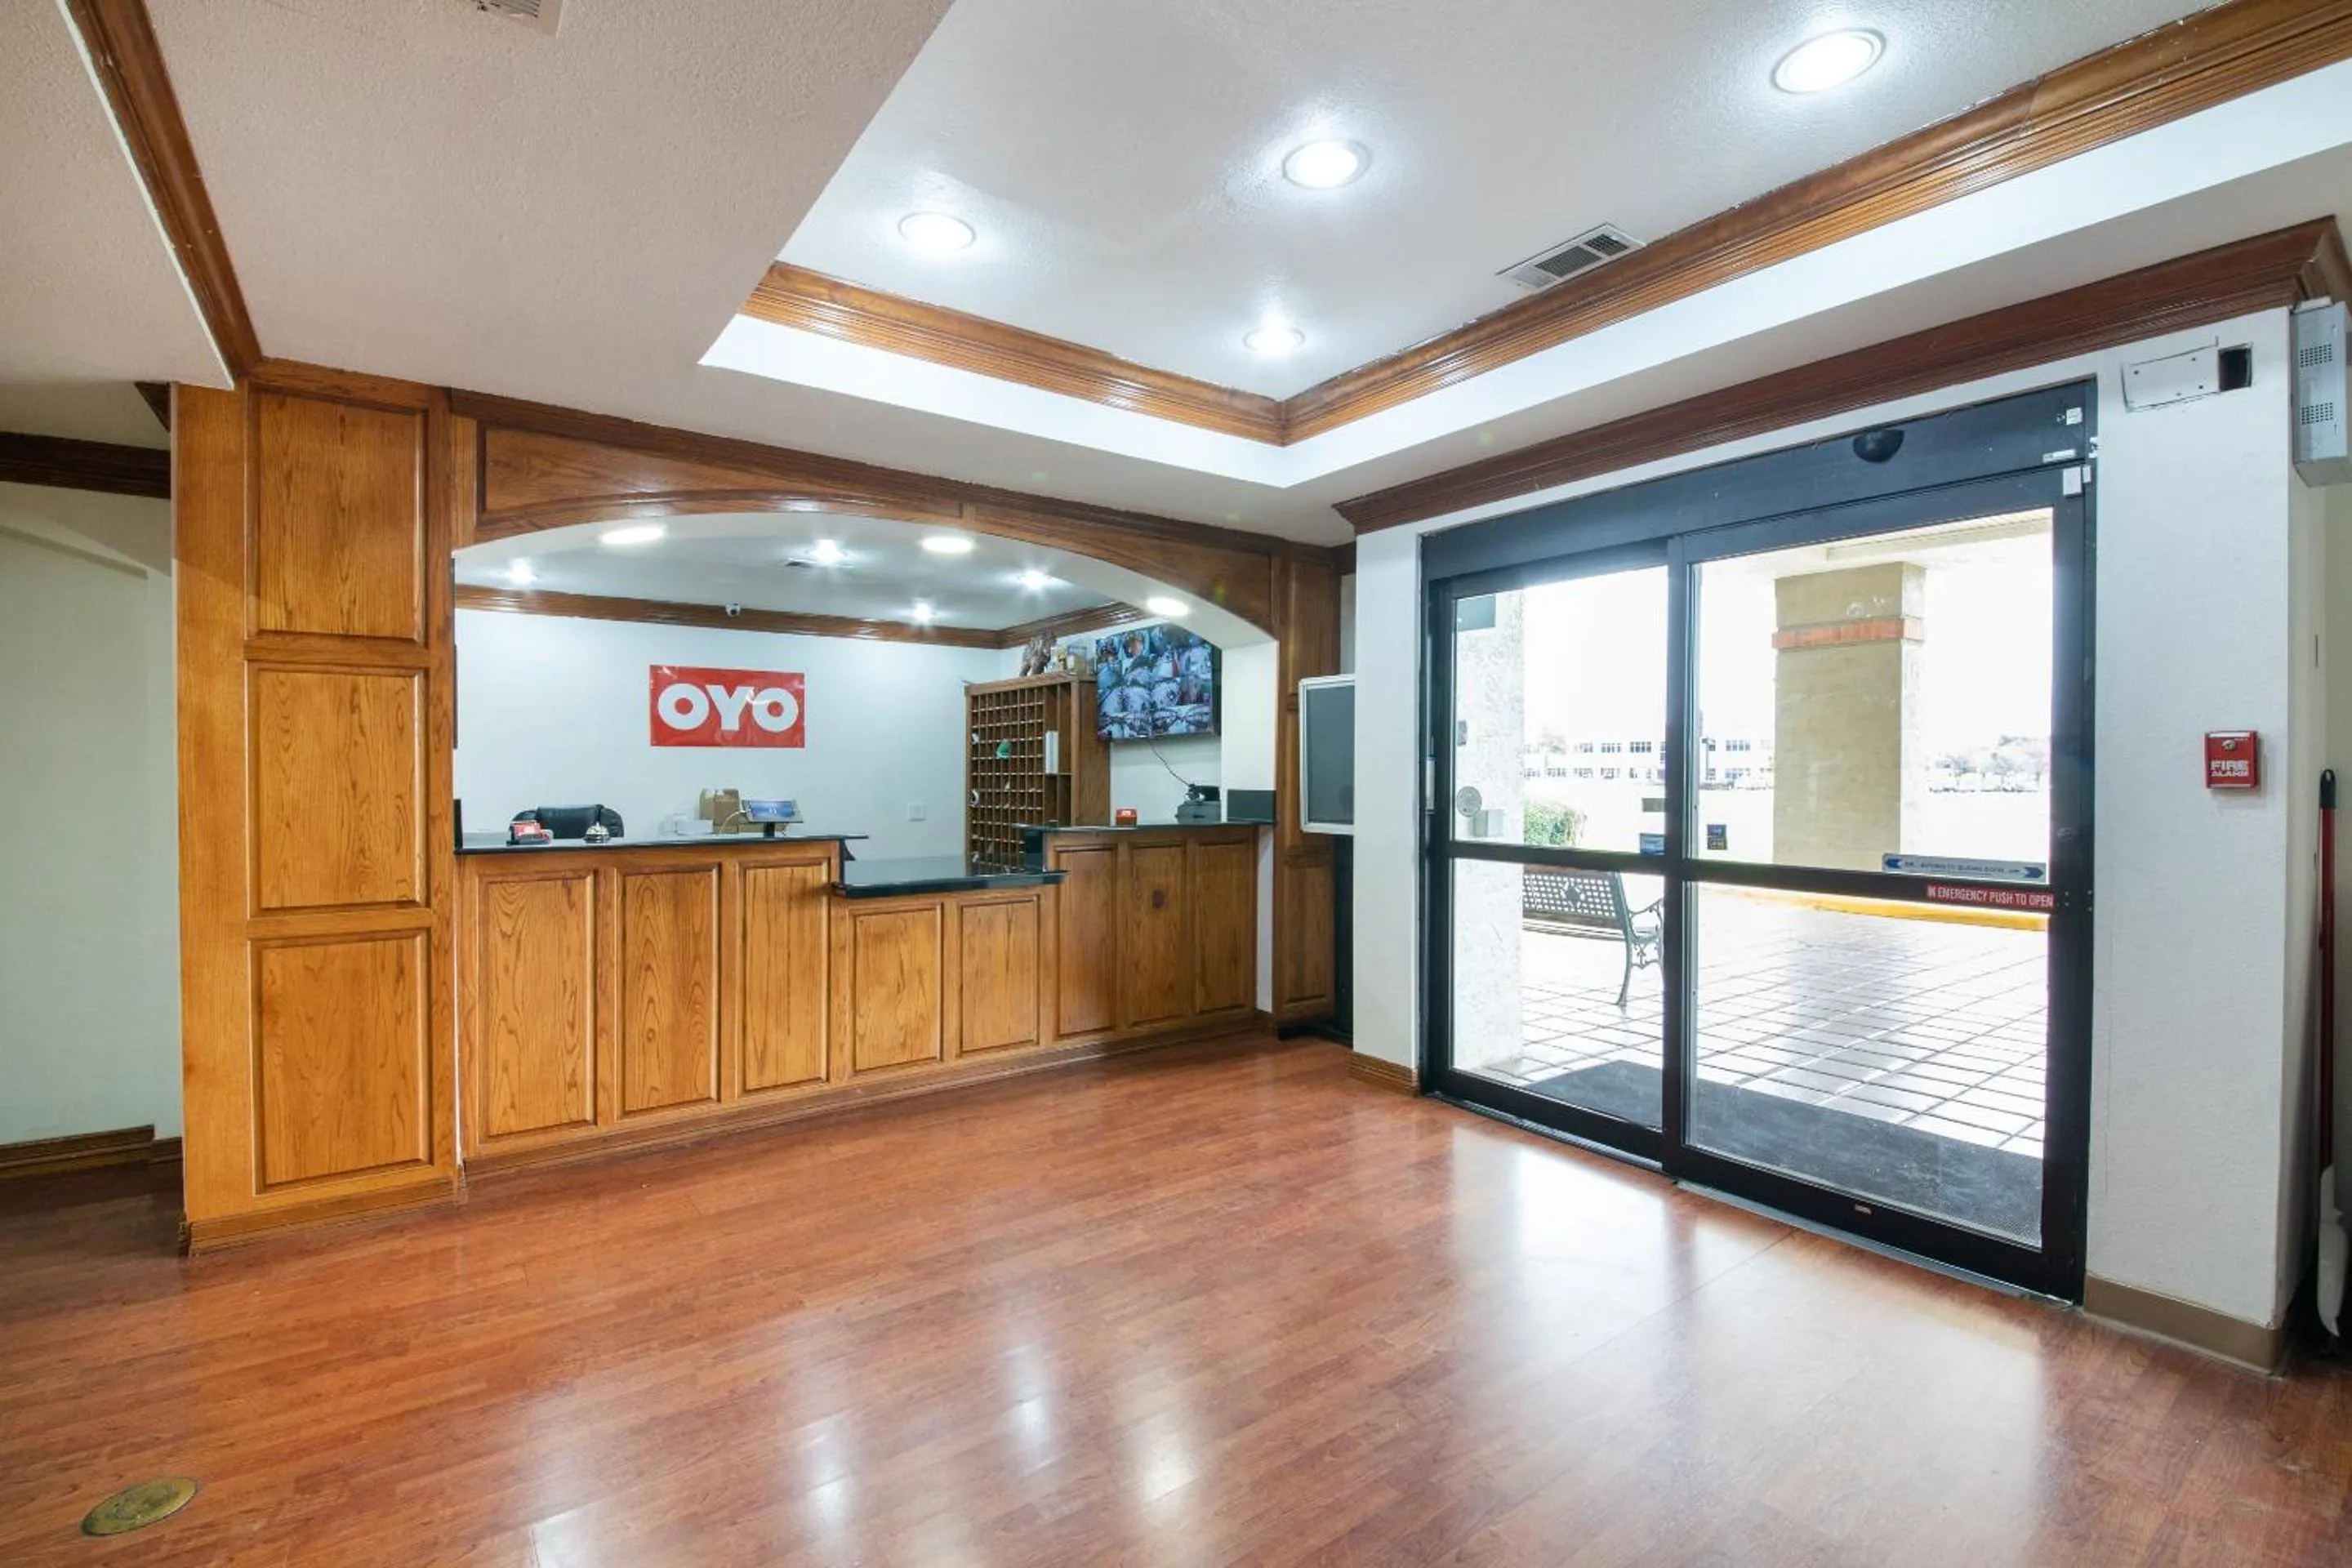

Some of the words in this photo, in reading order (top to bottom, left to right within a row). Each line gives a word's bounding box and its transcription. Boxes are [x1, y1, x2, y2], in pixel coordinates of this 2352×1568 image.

[657, 683, 799, 733] OYO
[2211, 760, 2248, 771] FIRE
[1938, 887, 1988, 902] EMERGENCY
[1989, 891, 2013, 904] PUSH
[2015, 893, 2027, 906] TO
[2029, 894, 2054, 907] OPEN
